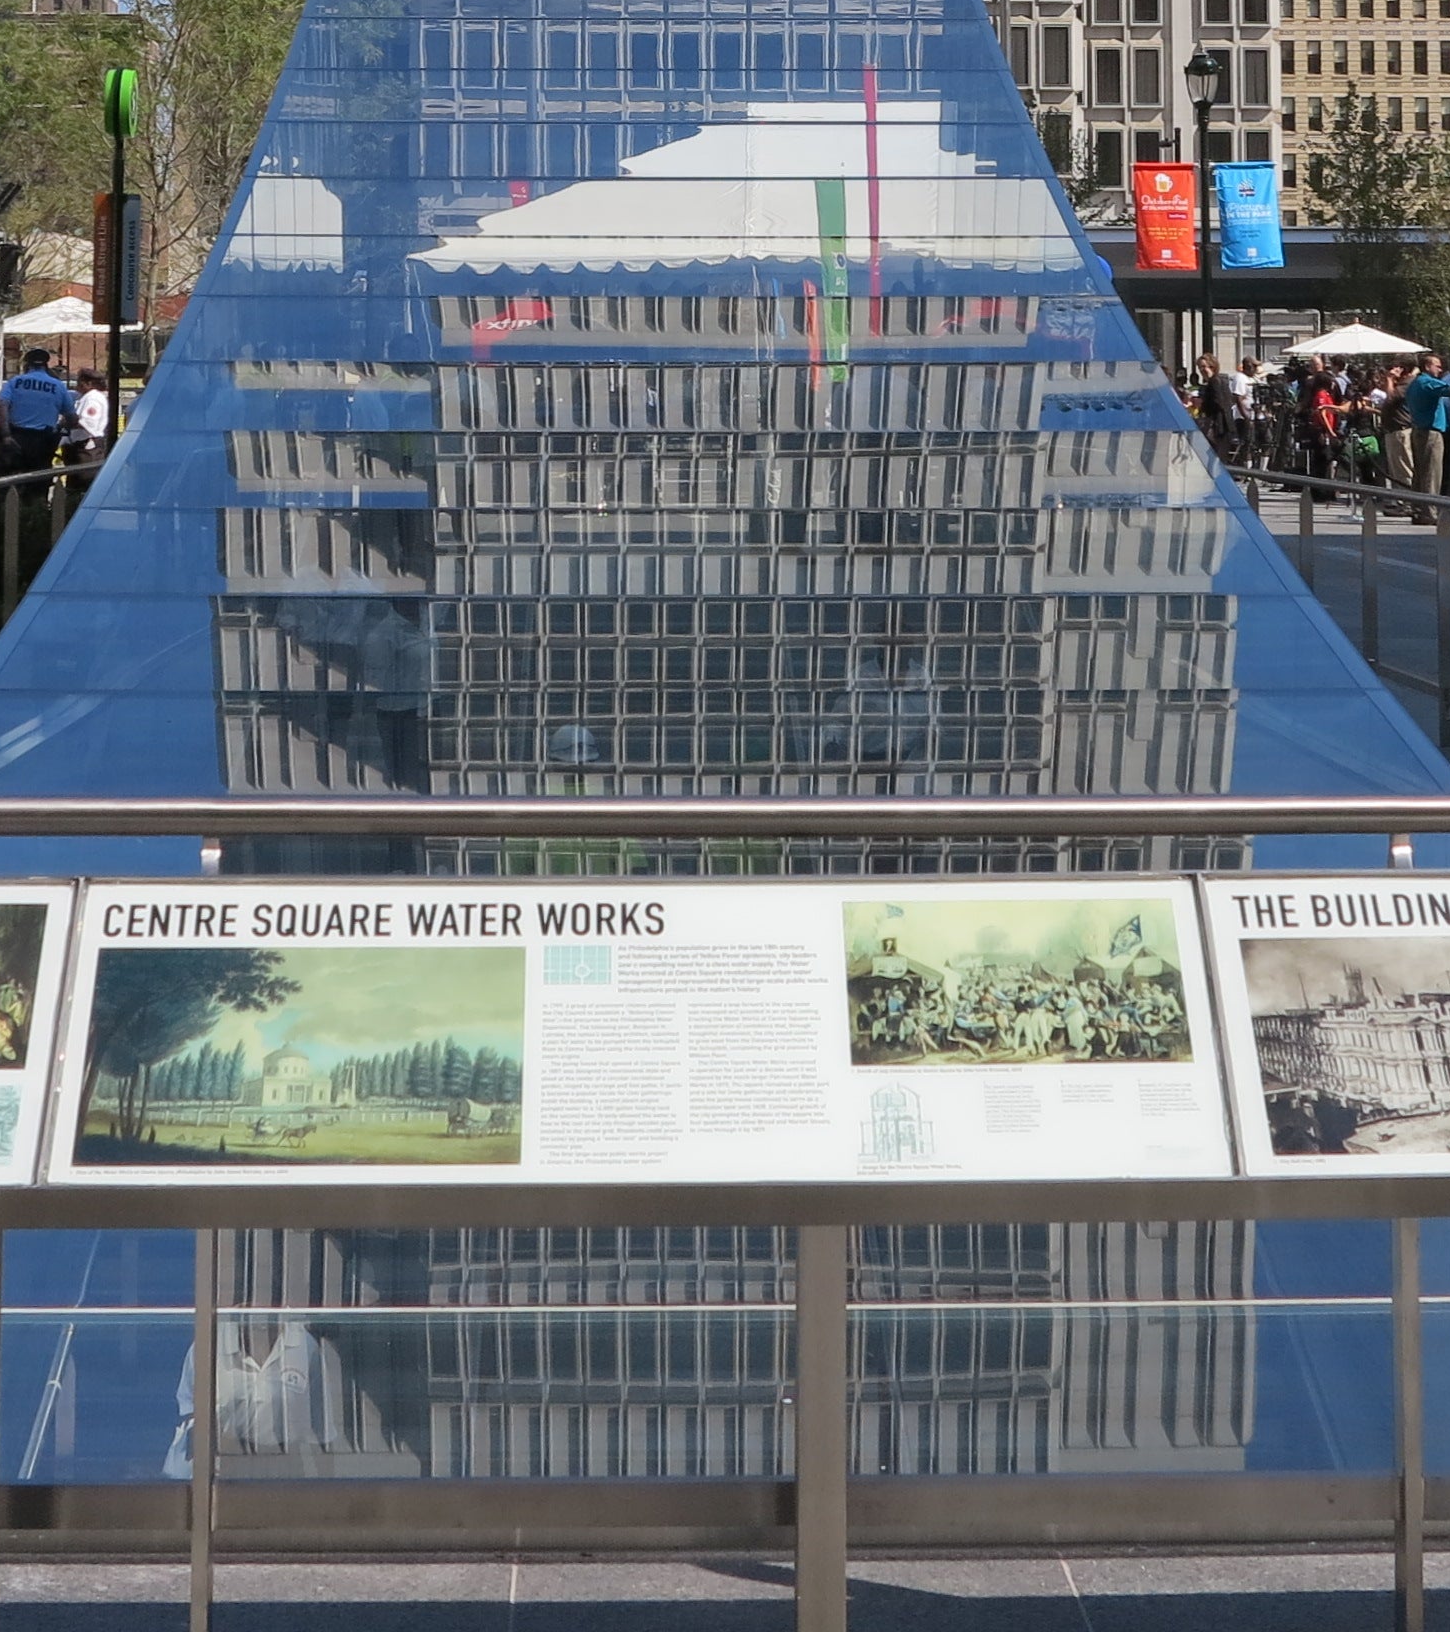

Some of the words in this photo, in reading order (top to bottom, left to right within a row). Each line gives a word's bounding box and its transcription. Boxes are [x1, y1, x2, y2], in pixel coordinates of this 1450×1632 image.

[128, 219, 137, 251] access
[125, 253, 137, 302] Concourse
[14, 377, 58, 394] POLICE
[102, 903, 239, 937] CENTRE
[251, 903, 393, 937] SQUARE
[407, 902, 522, 936] WATER
[536, 901, 666, 936] WORKS
[1231, 894, 1299, 928] THE
